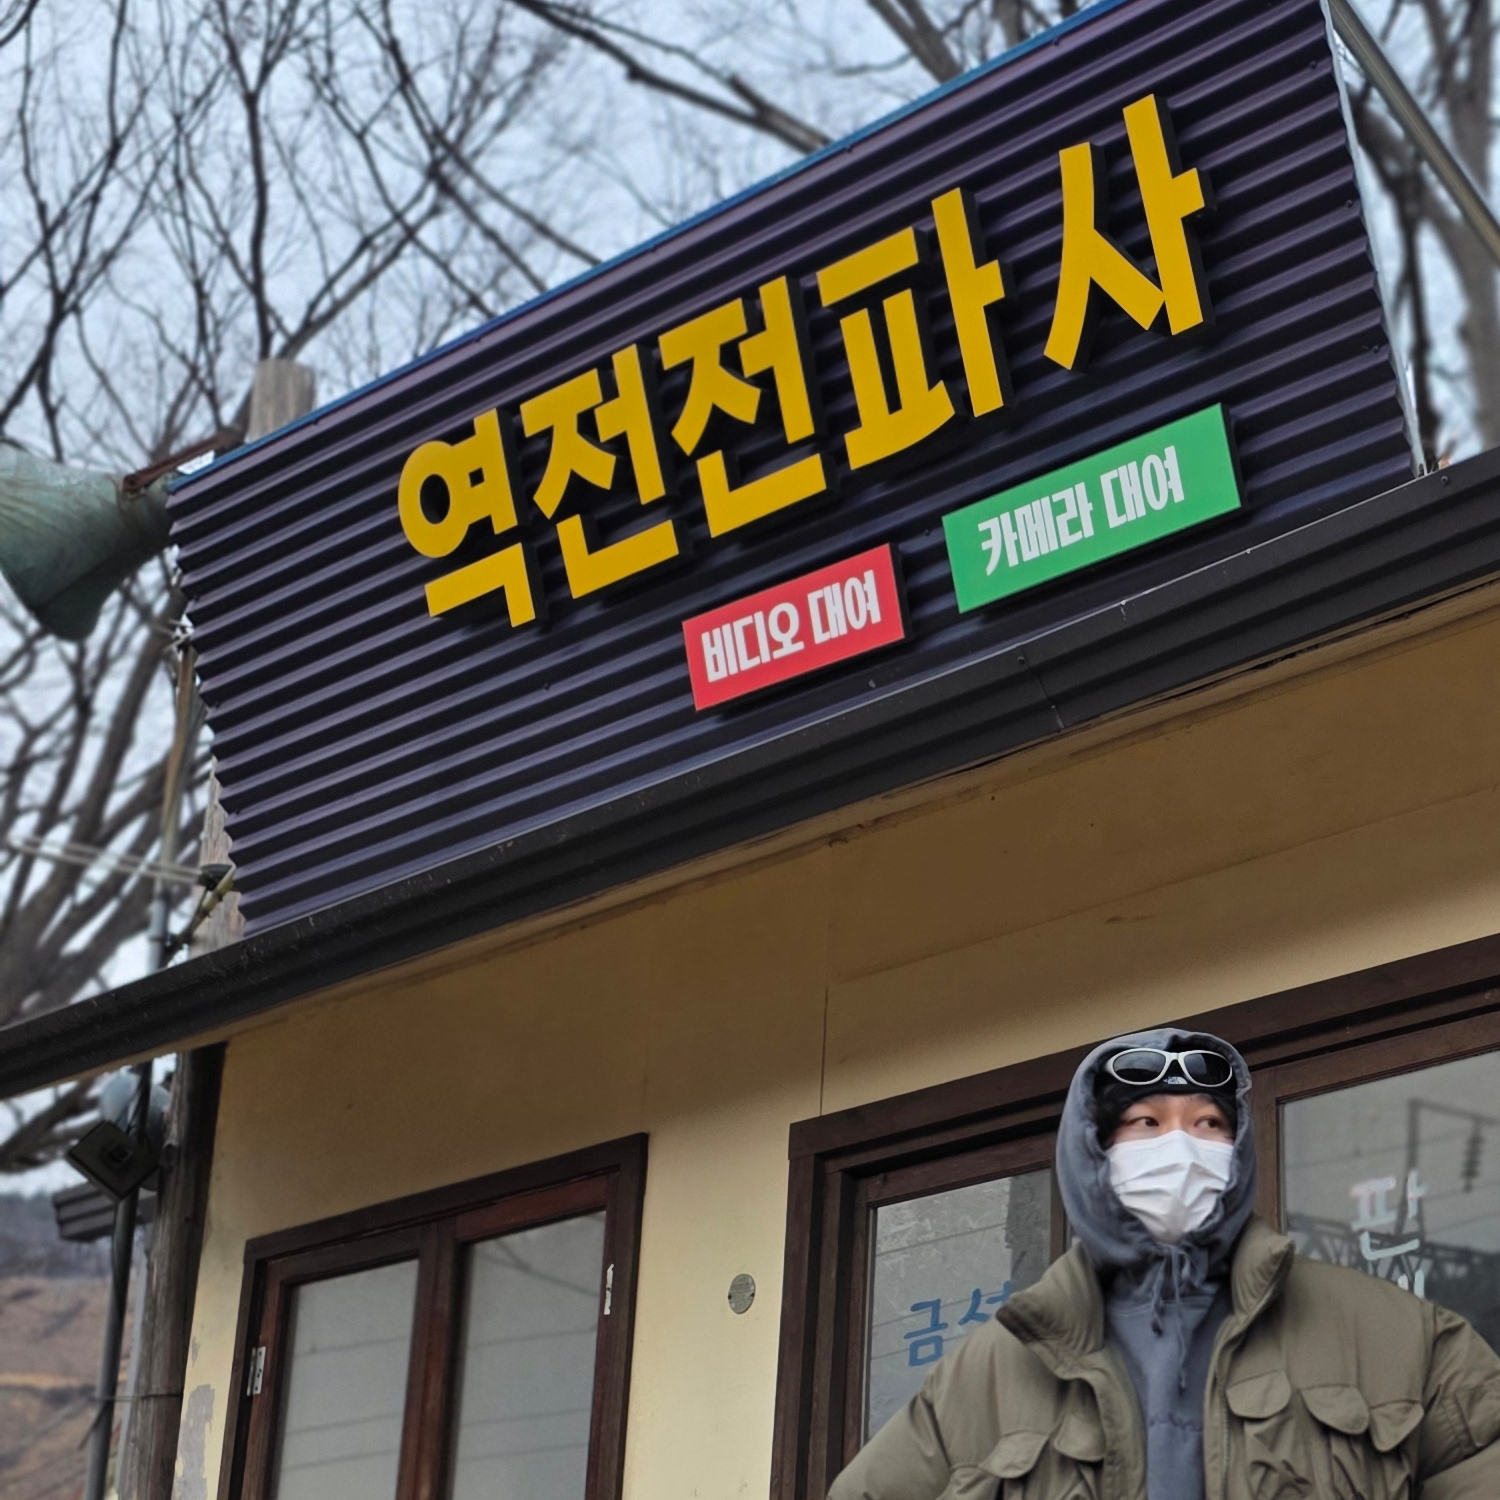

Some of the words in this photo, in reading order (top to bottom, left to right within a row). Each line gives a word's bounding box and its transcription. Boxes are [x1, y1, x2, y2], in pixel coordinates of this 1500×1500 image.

[399, 94, 1204, 628] 역전전파사
[977, 481, 1095, 576] 카메라
[1099, 445, 1185, 529] 대여
[700, 602, 805, 683] 비디오
[807, 569, 882, 645] 대여
[1349, 1169, 1428, 1299] 판
